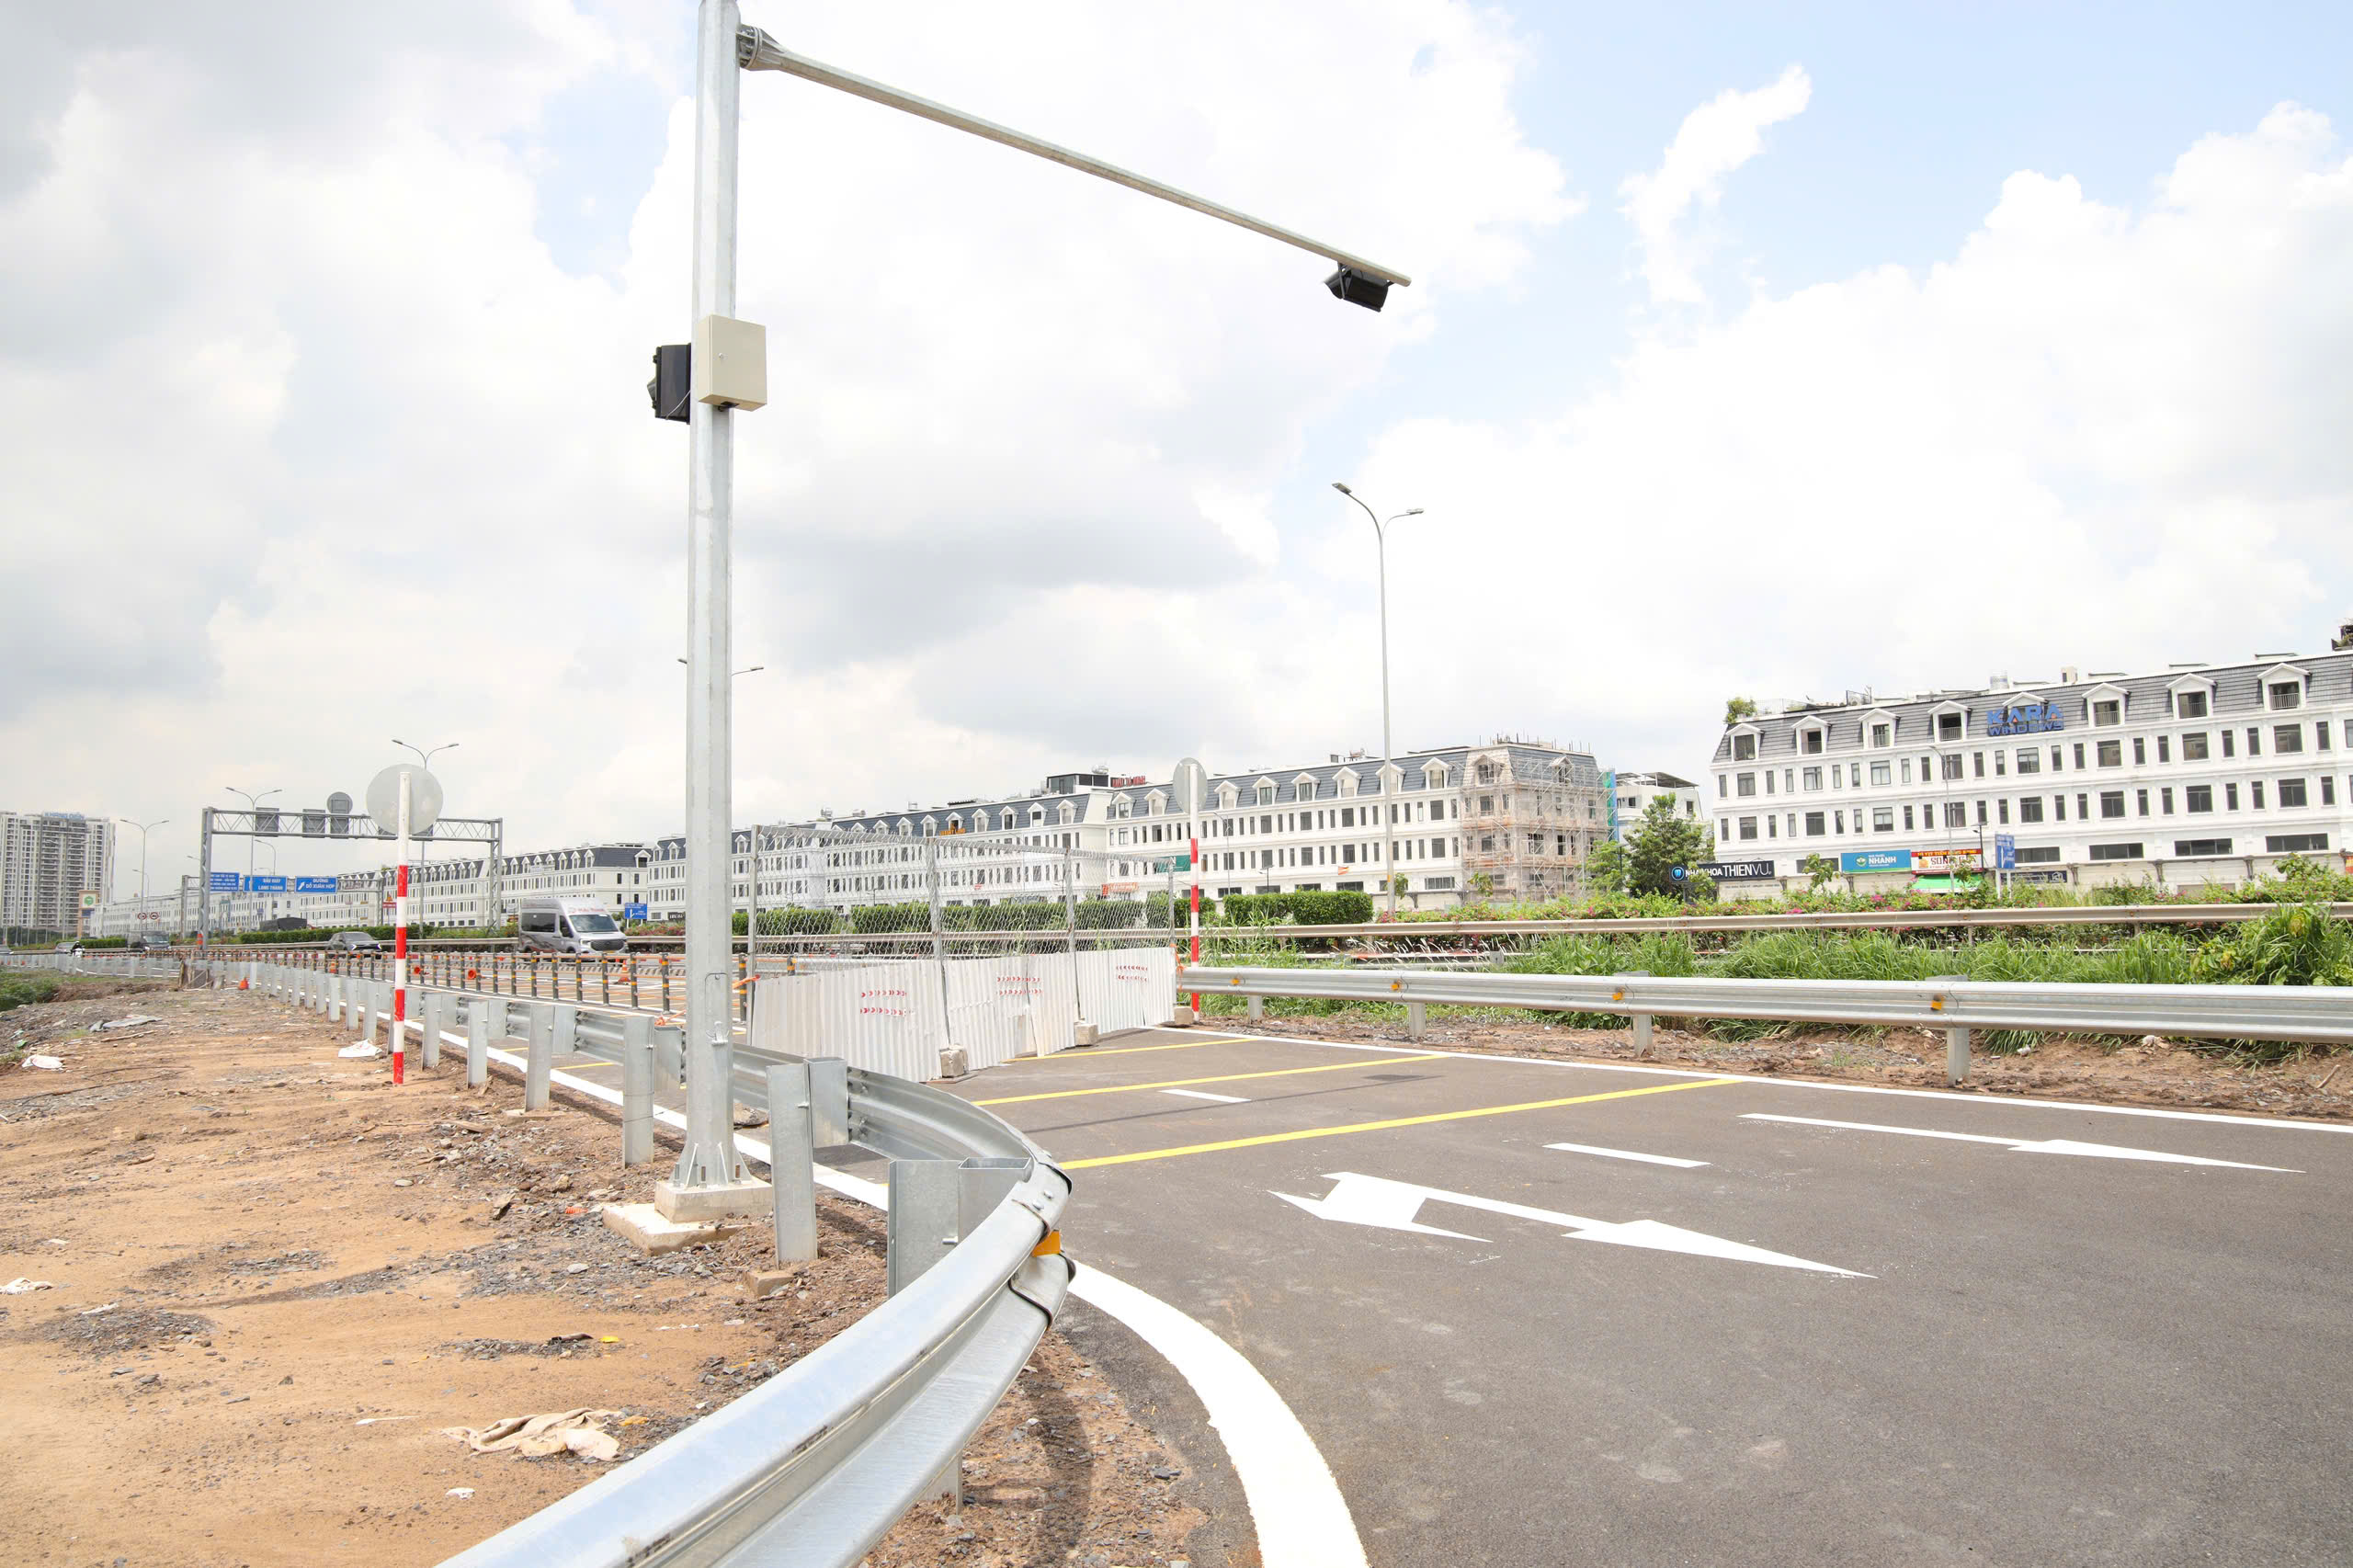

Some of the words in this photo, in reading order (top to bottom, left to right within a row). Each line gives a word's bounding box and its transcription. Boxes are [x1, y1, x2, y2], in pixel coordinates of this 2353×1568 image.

[1986, 704, 2063, 725] KARA
[1987, 720, 2064, 736] WINDOWS
[1868, 856, 1897, 865] NHANH
